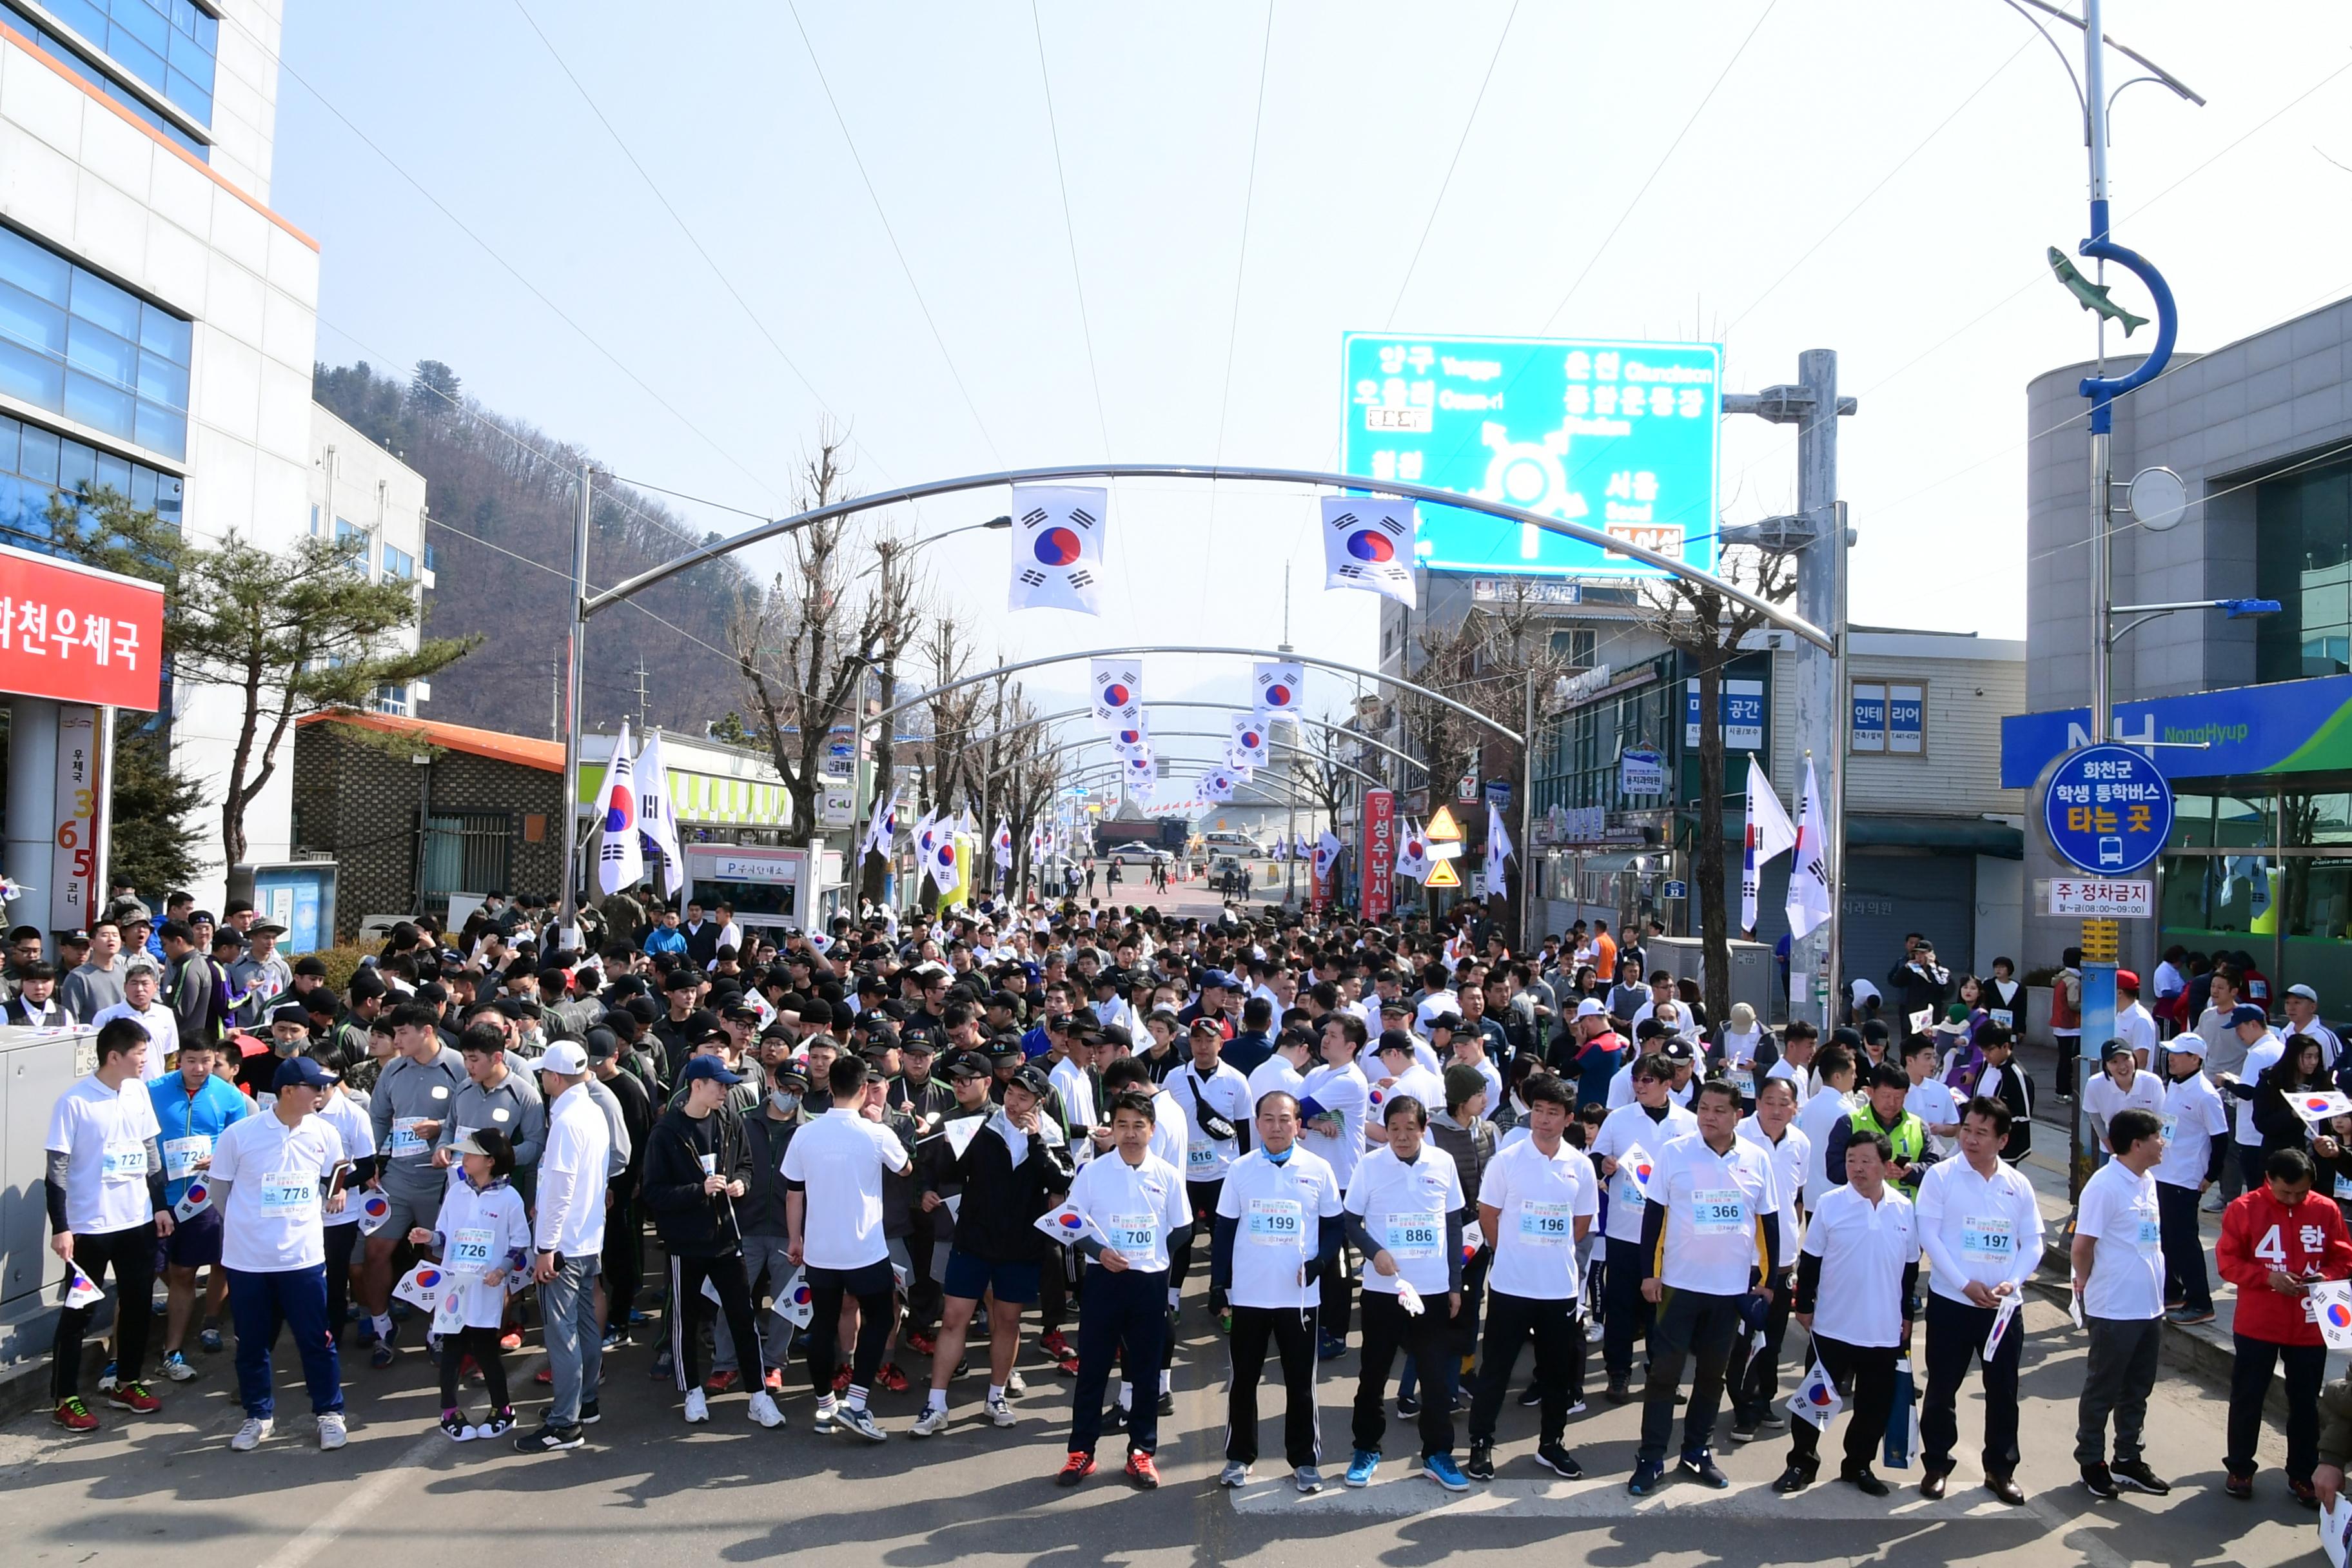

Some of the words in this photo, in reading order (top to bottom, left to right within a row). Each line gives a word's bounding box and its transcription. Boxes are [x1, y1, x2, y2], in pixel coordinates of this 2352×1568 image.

[1729, 700, 1759, 719] 공간
[73, 749, 83, 783] 우체국
[2083, 761, 2133, 779] 화천군
[2056, 784, 2090, 803] 학생
[2095, 783, 2161, 802] 통학버스
[2068, 806, 2118, 833] 타는
[2128, 805, 2151, 832] 곳
[67, 882, 78, 905] 코너
[121, 1153, 142, 1166] 727
[1191, 1151, 1212, 1162] 616
[279, 1187, 309, 1200] 778
[1712, 1205, 1739, 1218] 366
[1267, 1216, 1295, 1230] 199
[1539, 1218, 1565, 1231] 196
[1126, 1230, 1152, 1244] 700
[1406, 1229, 1433, 1242] 886
[1983, 1234, 2008, 1248] 197
[460, 1244, 487, 1258] 726
[2255, 1224, 2286, 1264] 4
